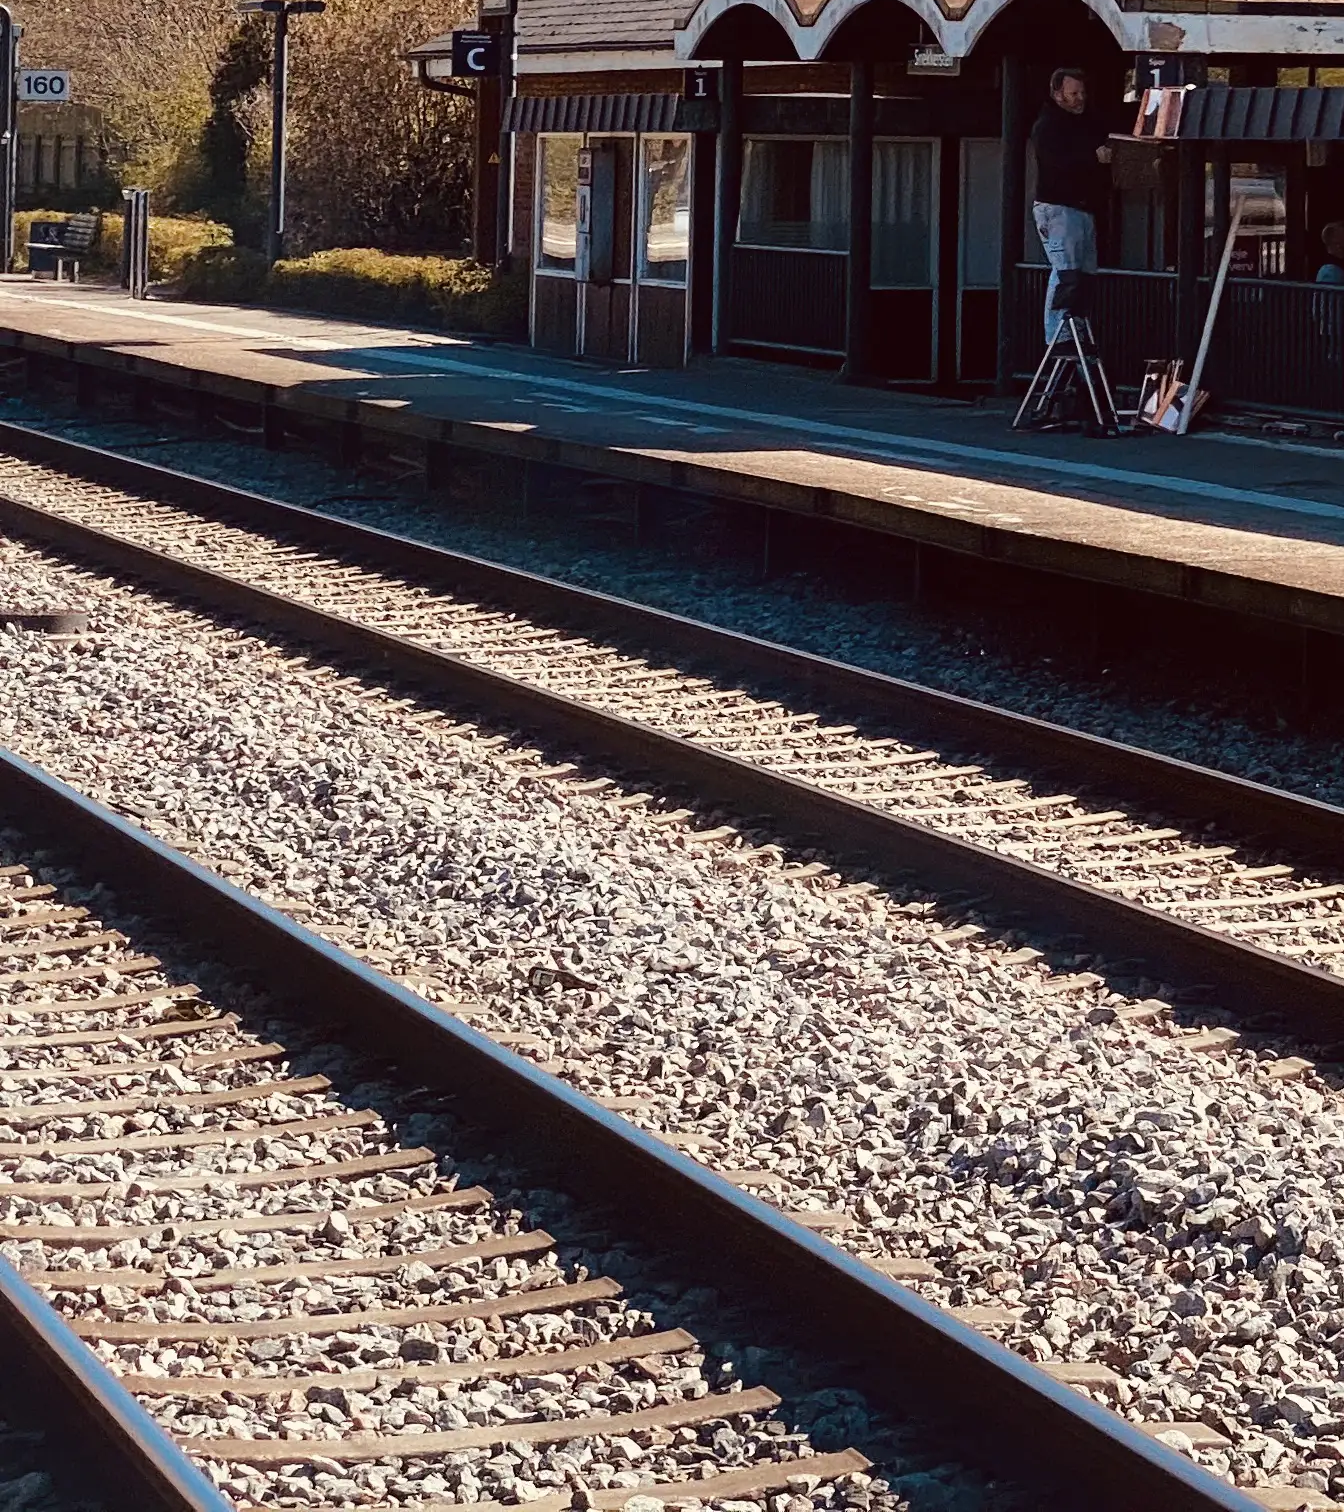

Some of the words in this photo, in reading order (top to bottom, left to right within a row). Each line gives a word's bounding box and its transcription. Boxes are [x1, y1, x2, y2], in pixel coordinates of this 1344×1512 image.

[466, 47, 486, 71] C
[24, 75, 65, 95] 160
[694, 78, 707, 97] 1
[1150, 68, 1160, 88] 1
